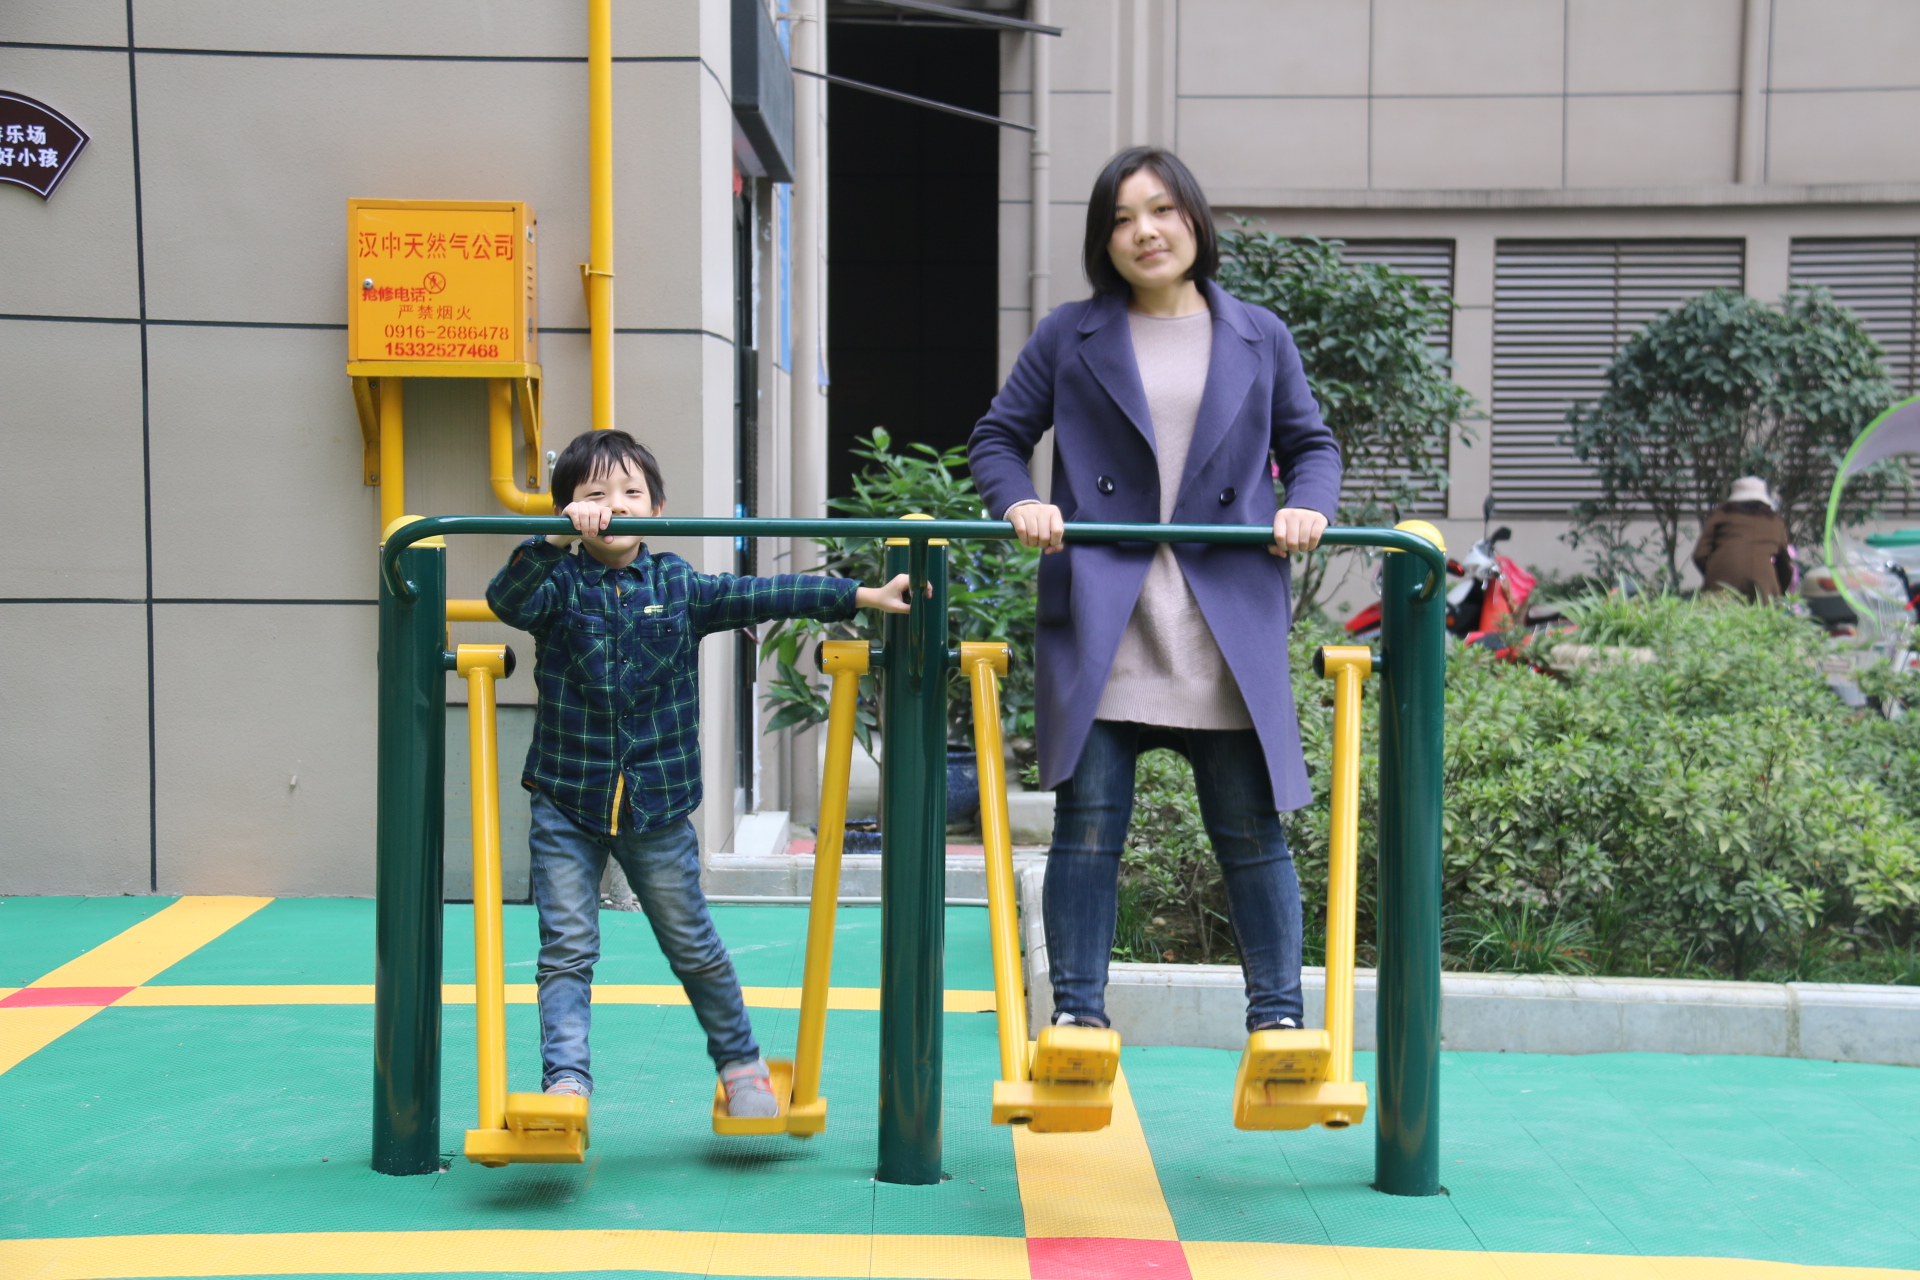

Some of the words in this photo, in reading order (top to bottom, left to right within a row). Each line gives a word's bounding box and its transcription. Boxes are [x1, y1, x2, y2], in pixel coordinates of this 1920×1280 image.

[0, 124, 47, 145] 乐场
[0, 147, 59, 168] 好小孩
[358, 231, 514, 261] 汉中天然气公司
[398, 304, 472, 321] 严禁烟火
[384, 324, 510, 341] 0916-2686478
[385, 341, 500, 359] 15332527468
